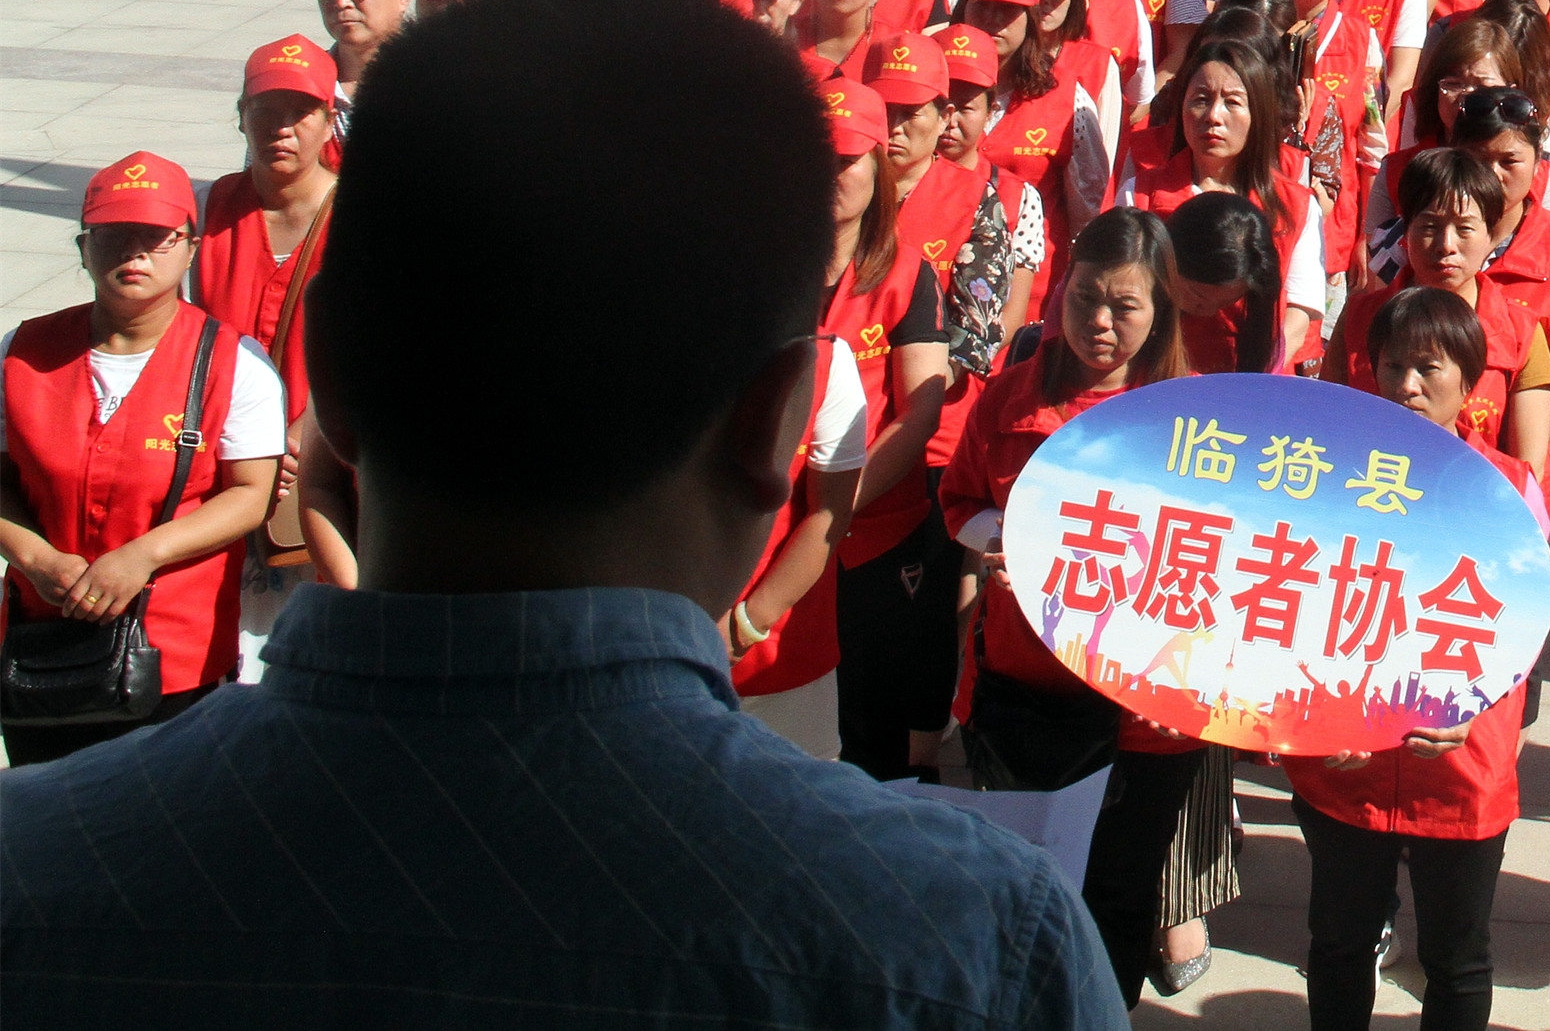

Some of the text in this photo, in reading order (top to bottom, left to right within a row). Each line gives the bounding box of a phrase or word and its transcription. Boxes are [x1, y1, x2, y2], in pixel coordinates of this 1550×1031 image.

[145, 438, 208, 453] 阳光者
[1166, 416, 1425, 516] 临猗县
[1041, 489, 1506, 684] 志愿者协会
